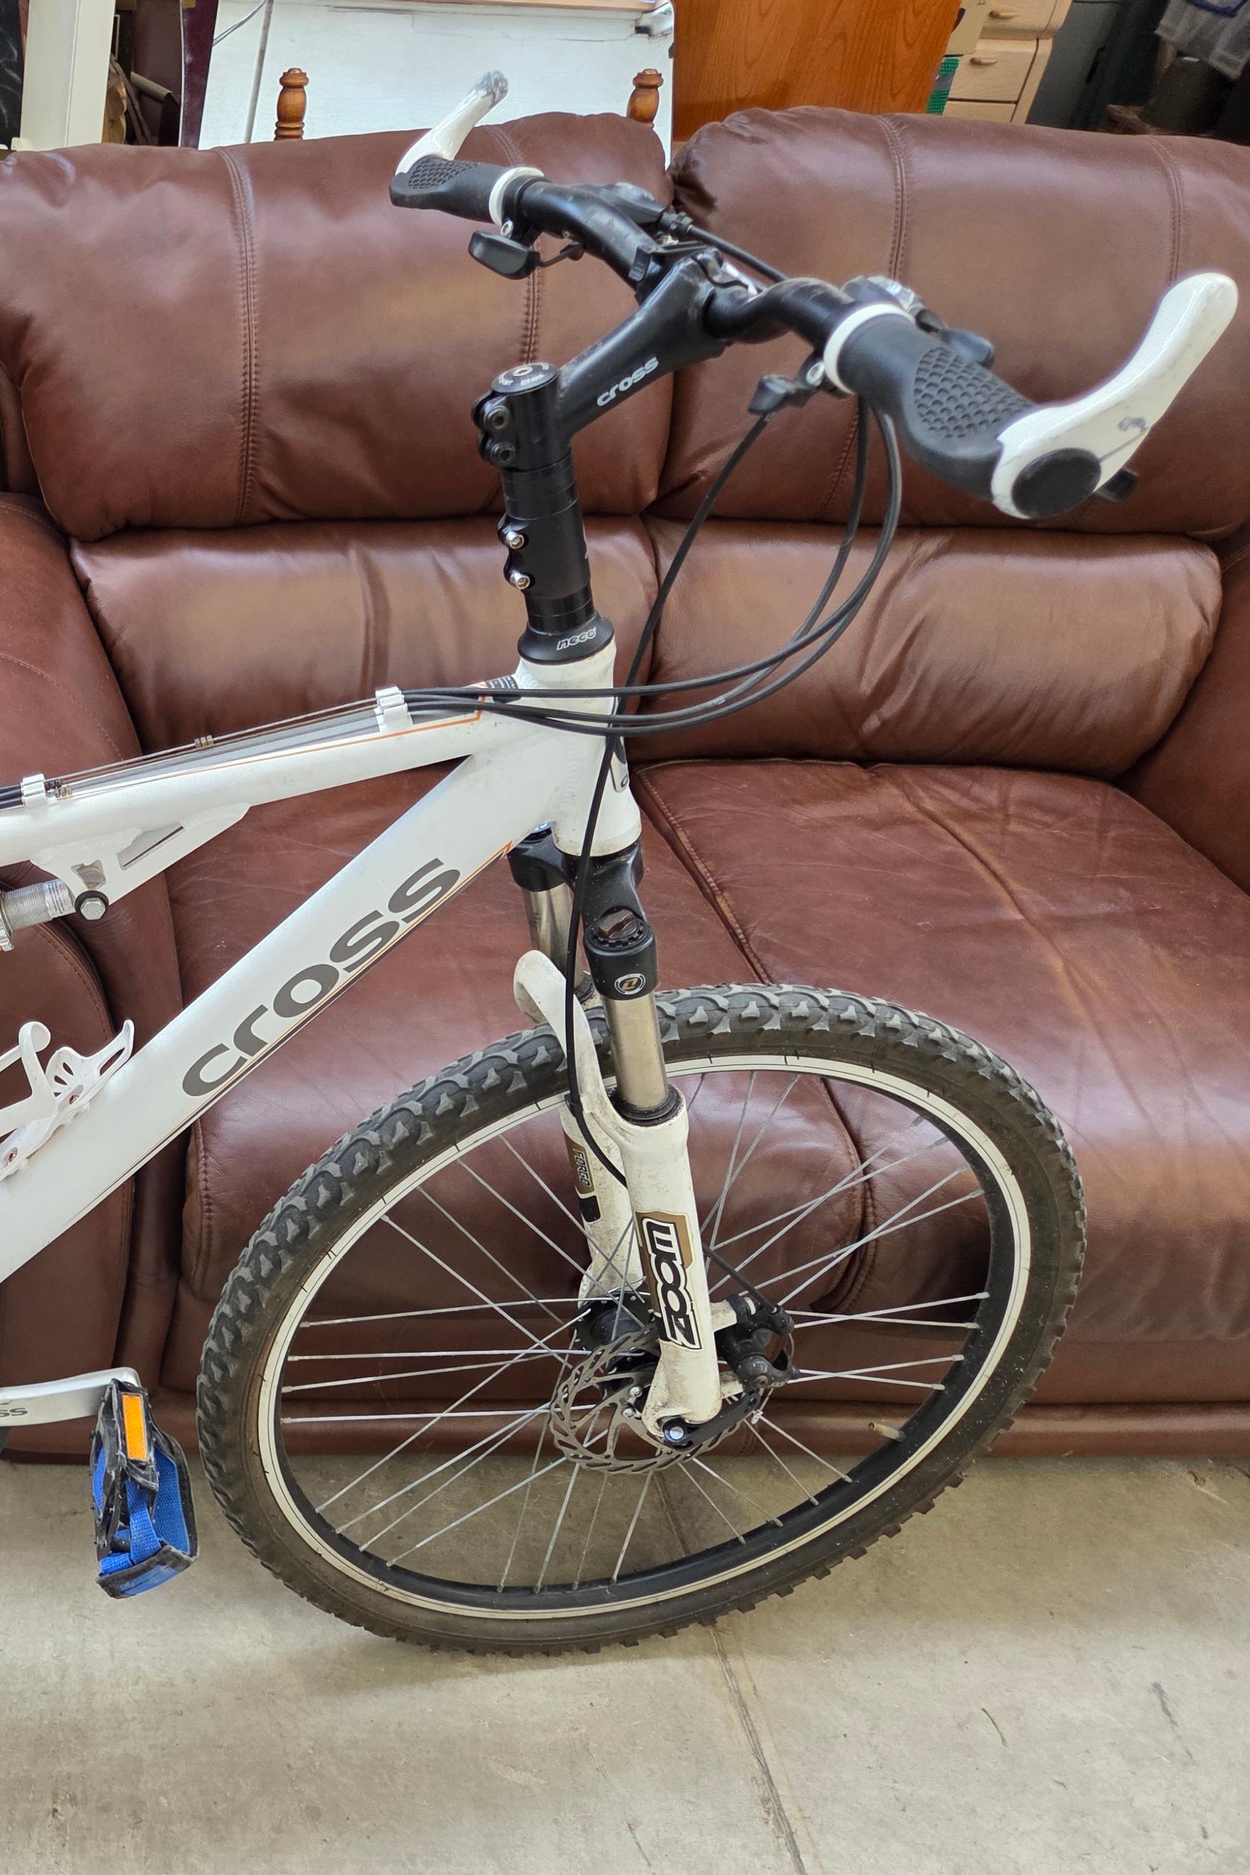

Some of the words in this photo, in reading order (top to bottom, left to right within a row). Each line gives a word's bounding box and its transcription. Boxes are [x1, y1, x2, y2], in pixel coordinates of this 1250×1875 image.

[596, 356, 659, 407] cross
[556, 627, 597, 651] neco
[182, 857, 461, 1097] cross
